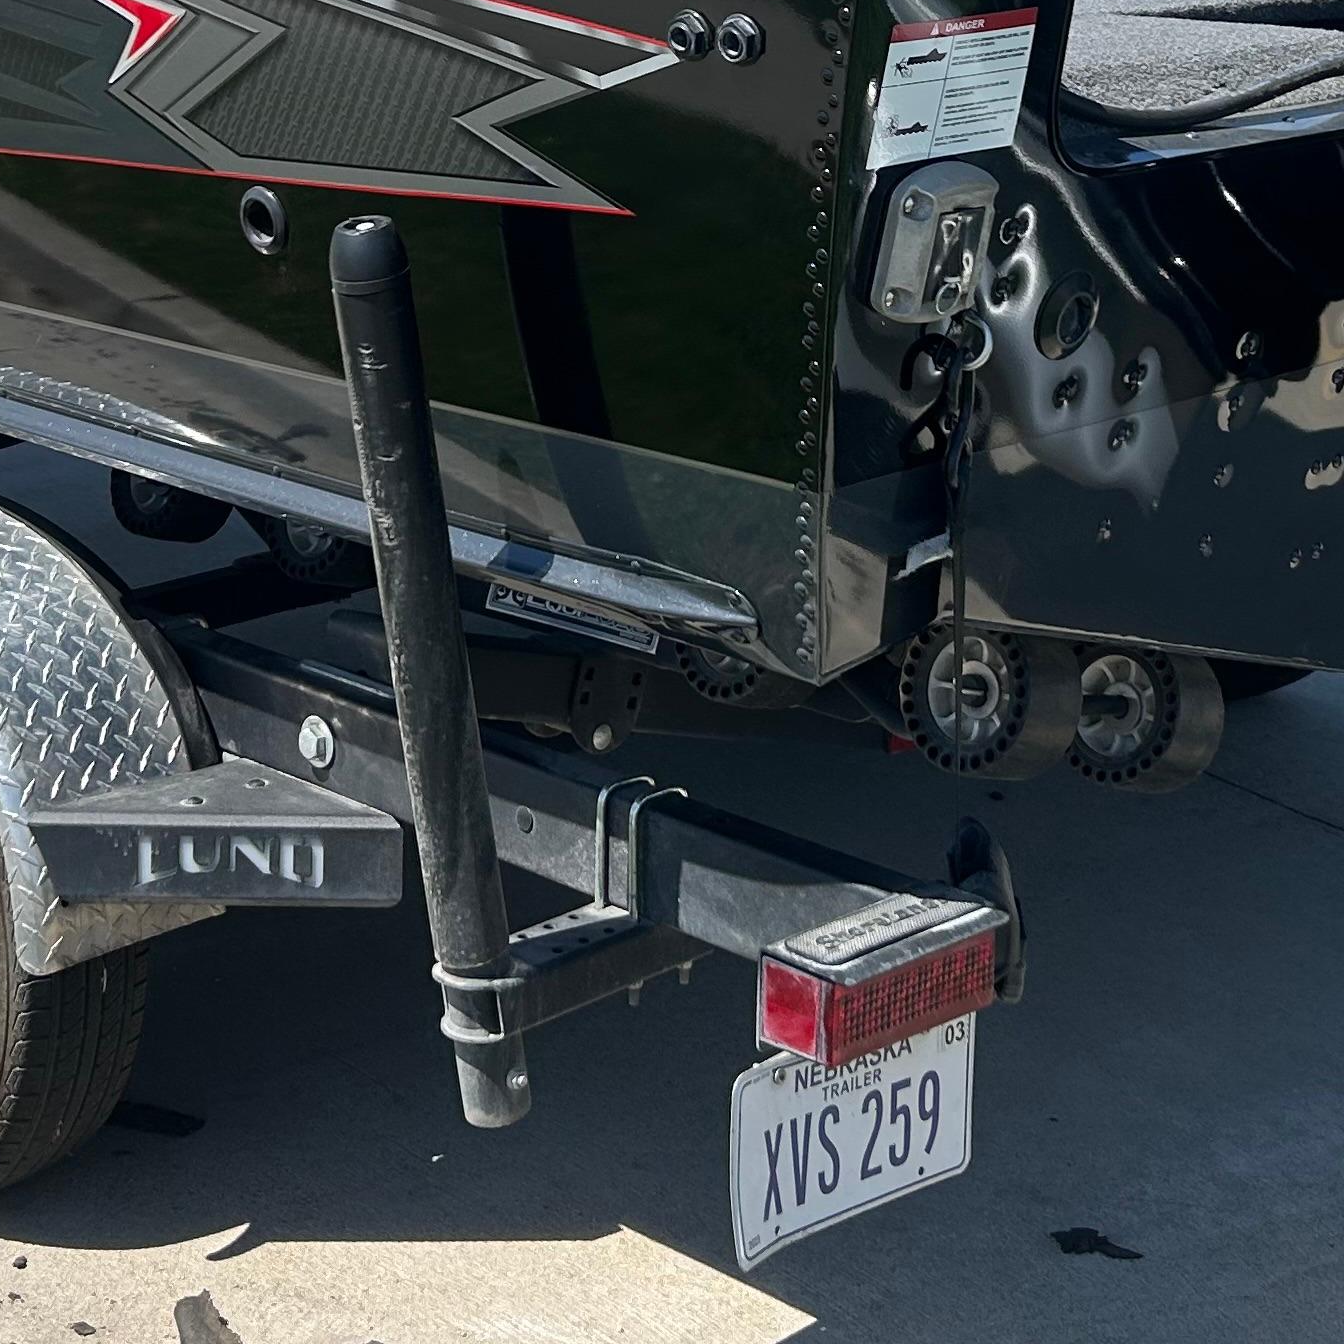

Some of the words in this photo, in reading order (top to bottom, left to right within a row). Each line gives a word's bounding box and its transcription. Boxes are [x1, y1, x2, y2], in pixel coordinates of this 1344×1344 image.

[945, 19, 985, 33] DANGER
[133, 834, 324, 889] LUND
[945, 1020, 966, 1045] 03
[821, 1068, 882, 1102] TRAILER
[763, 1104, 841, 1223] XVS
[860, 1070, 941, 1181] 259
